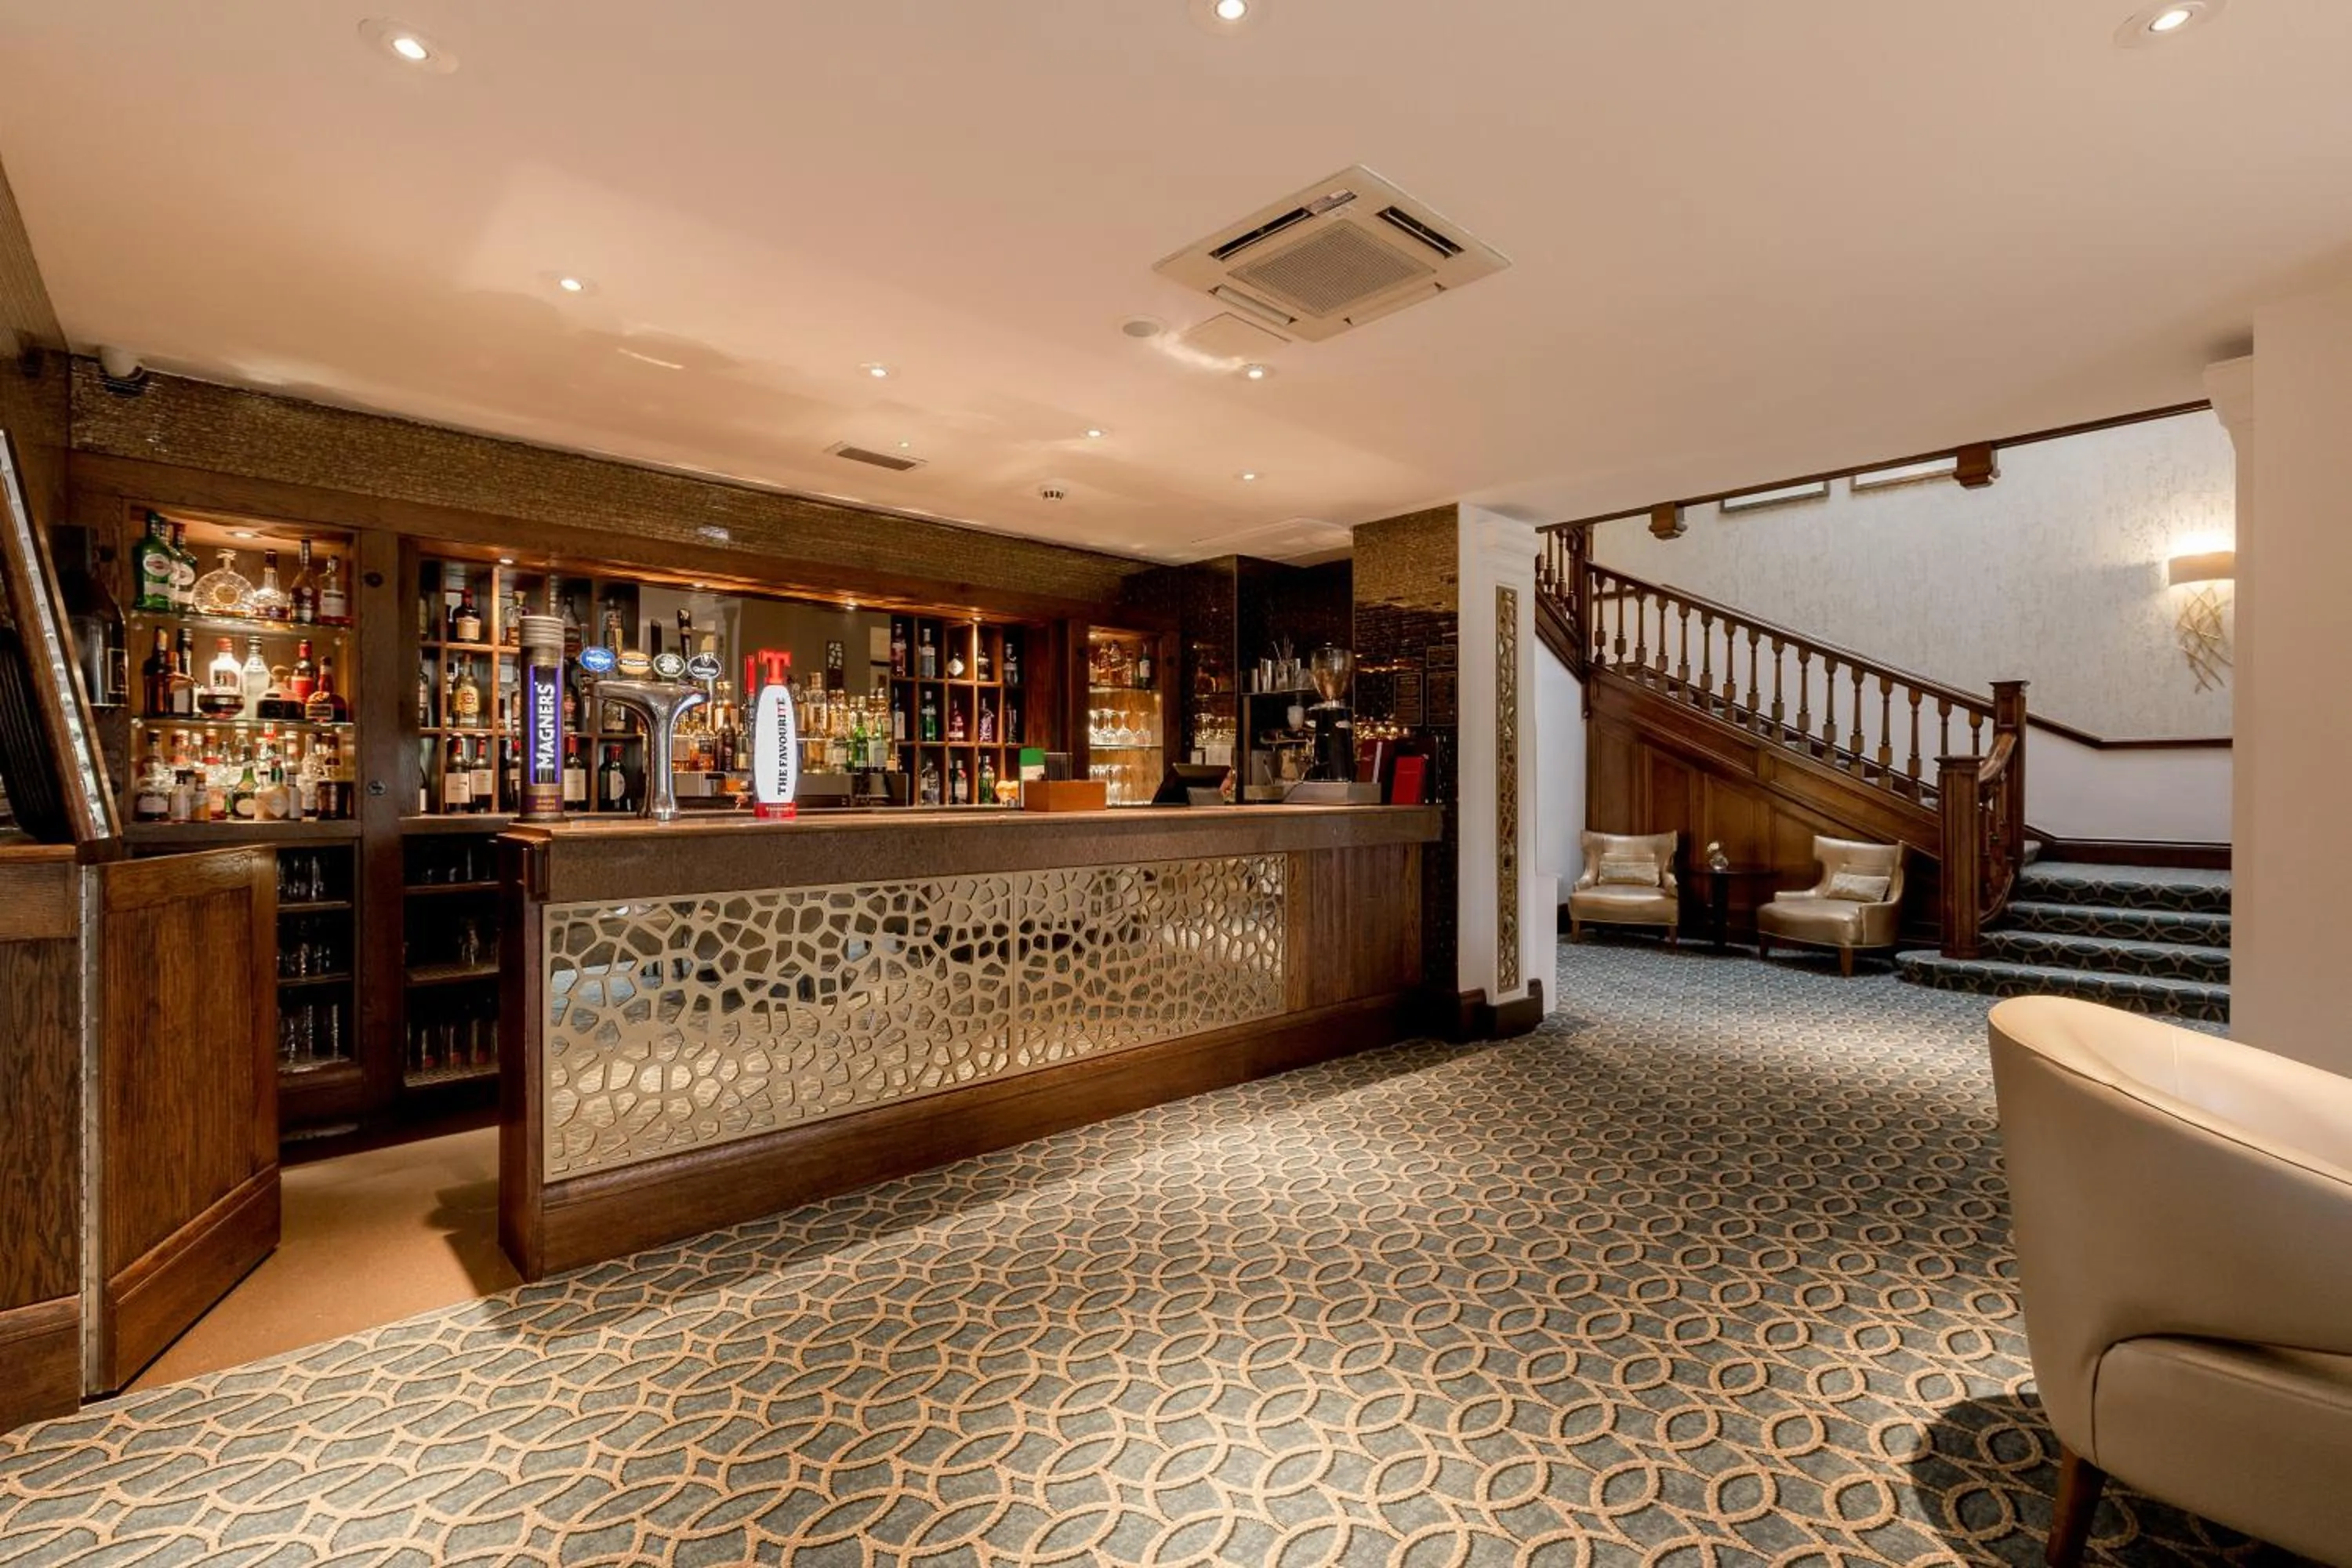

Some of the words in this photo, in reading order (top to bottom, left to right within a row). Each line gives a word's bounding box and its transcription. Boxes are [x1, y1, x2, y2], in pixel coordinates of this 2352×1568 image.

[759, 650, 791, 684] T
[536, 683, 555, 769] MAGNERS
[777, 698, 787, 767] FAVOURITE
[778, 769, 787, 795] THE
